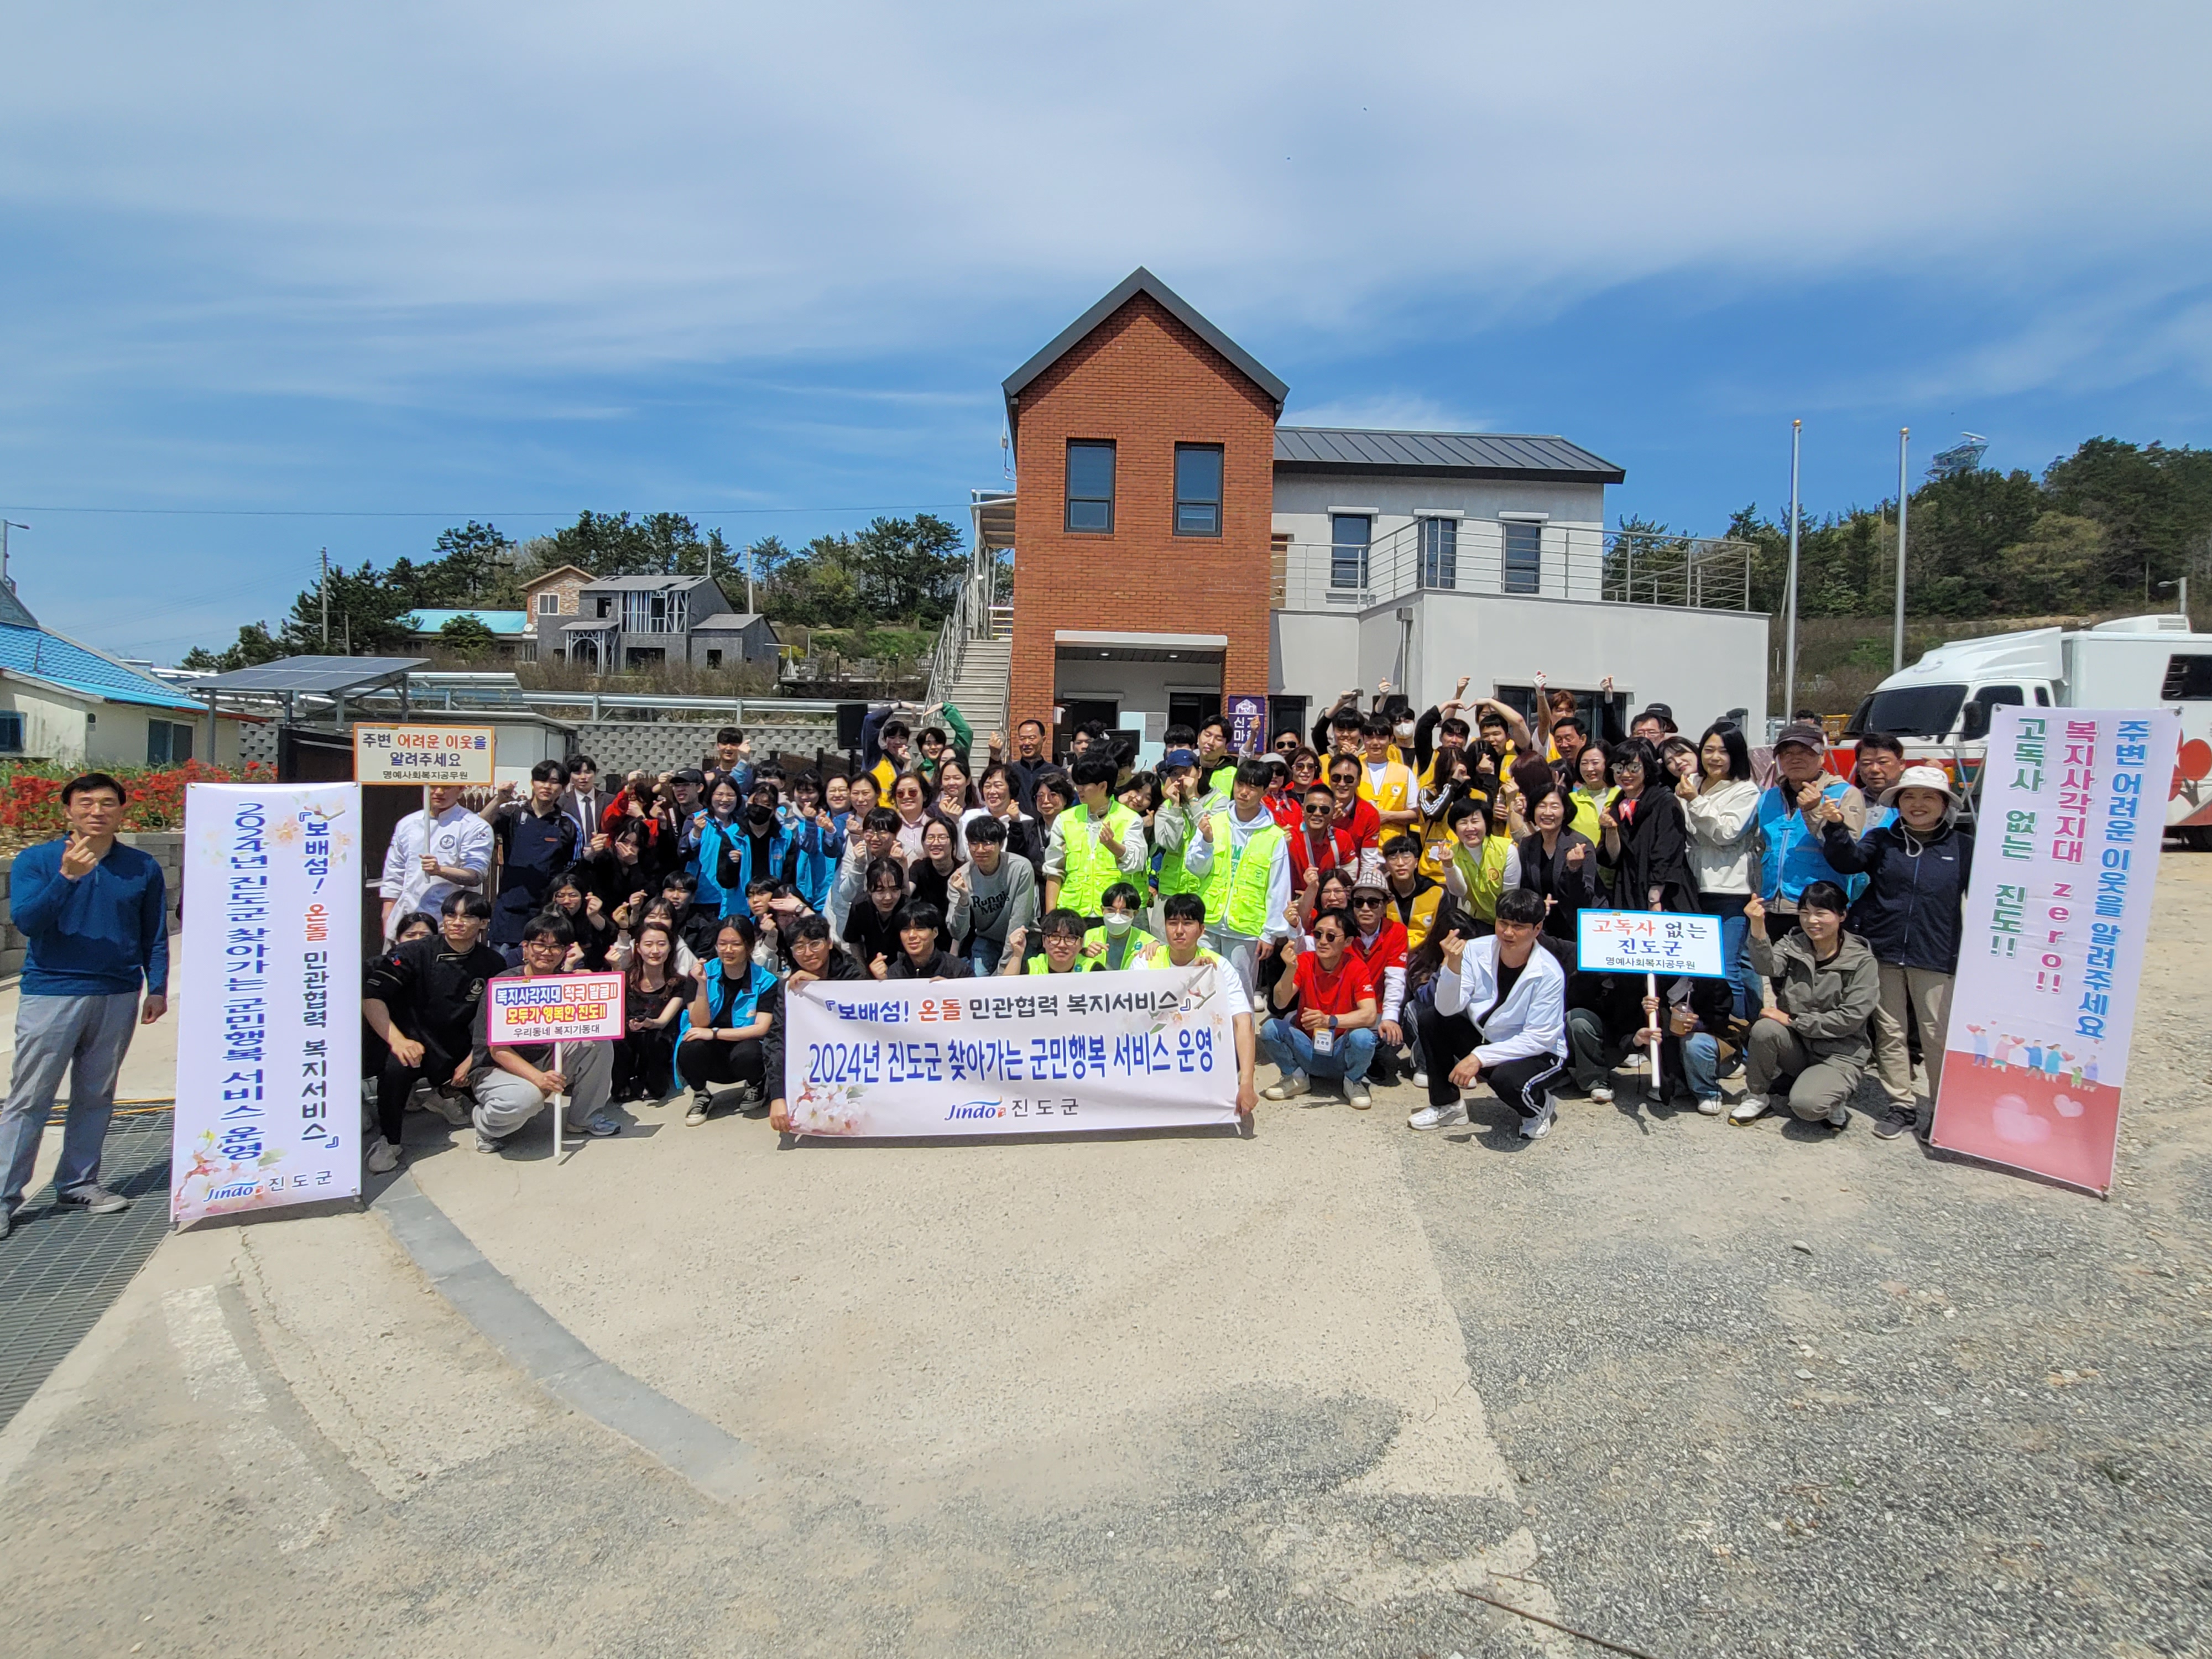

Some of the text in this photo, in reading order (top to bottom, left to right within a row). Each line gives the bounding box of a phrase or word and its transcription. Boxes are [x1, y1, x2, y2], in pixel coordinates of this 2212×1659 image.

[1234, 717, 1261, 728] 신
[363, 733, 487, 750] 주변 어려운 이웃을
[390, 752, 461, 767] 알려주세요
[383, 771, 468, 780] 명예사회복지공무원
[1989, 718, 2046, 959] 고독사 없는 진도!!
[2036, 721, 2097, 993] 복지사각지대 zero!!
[2075, 721, 2149, 1040] 주변 어려운 이웃을 알려주세요
[304, 904, 329, 942] 온돌
[1592, 919, 1707, 939] 고독사 없는
[1617, 938, 1682, 956] 진도군
[1605, 957, 1695, 970] 명예사회복지공무원
[221, 803, 271, 1161] 2024년 진도군 찾아가는 군민행복 서비스 운영
[302, 951, 330, 1028] 민관협력
[495, 982, 618, 1005] 복지사각지대 적극 발굴!!
[507, 1003, 607, 1024] 모두가 행복한 진도!!
[917, 998, 961, 1022] 온돌
[969, 994, 1057, 1019] 민관협력
[514, 1024, 599, 1037] 우리동네 복지기동대
[809, 1026, 1213, 1084] 2024년 진도군 찾아가는 군민행복 서비스 운영
[945, 1099, 997, 1121] Jindo
[204, 1182, 254, 1202] Jindo
